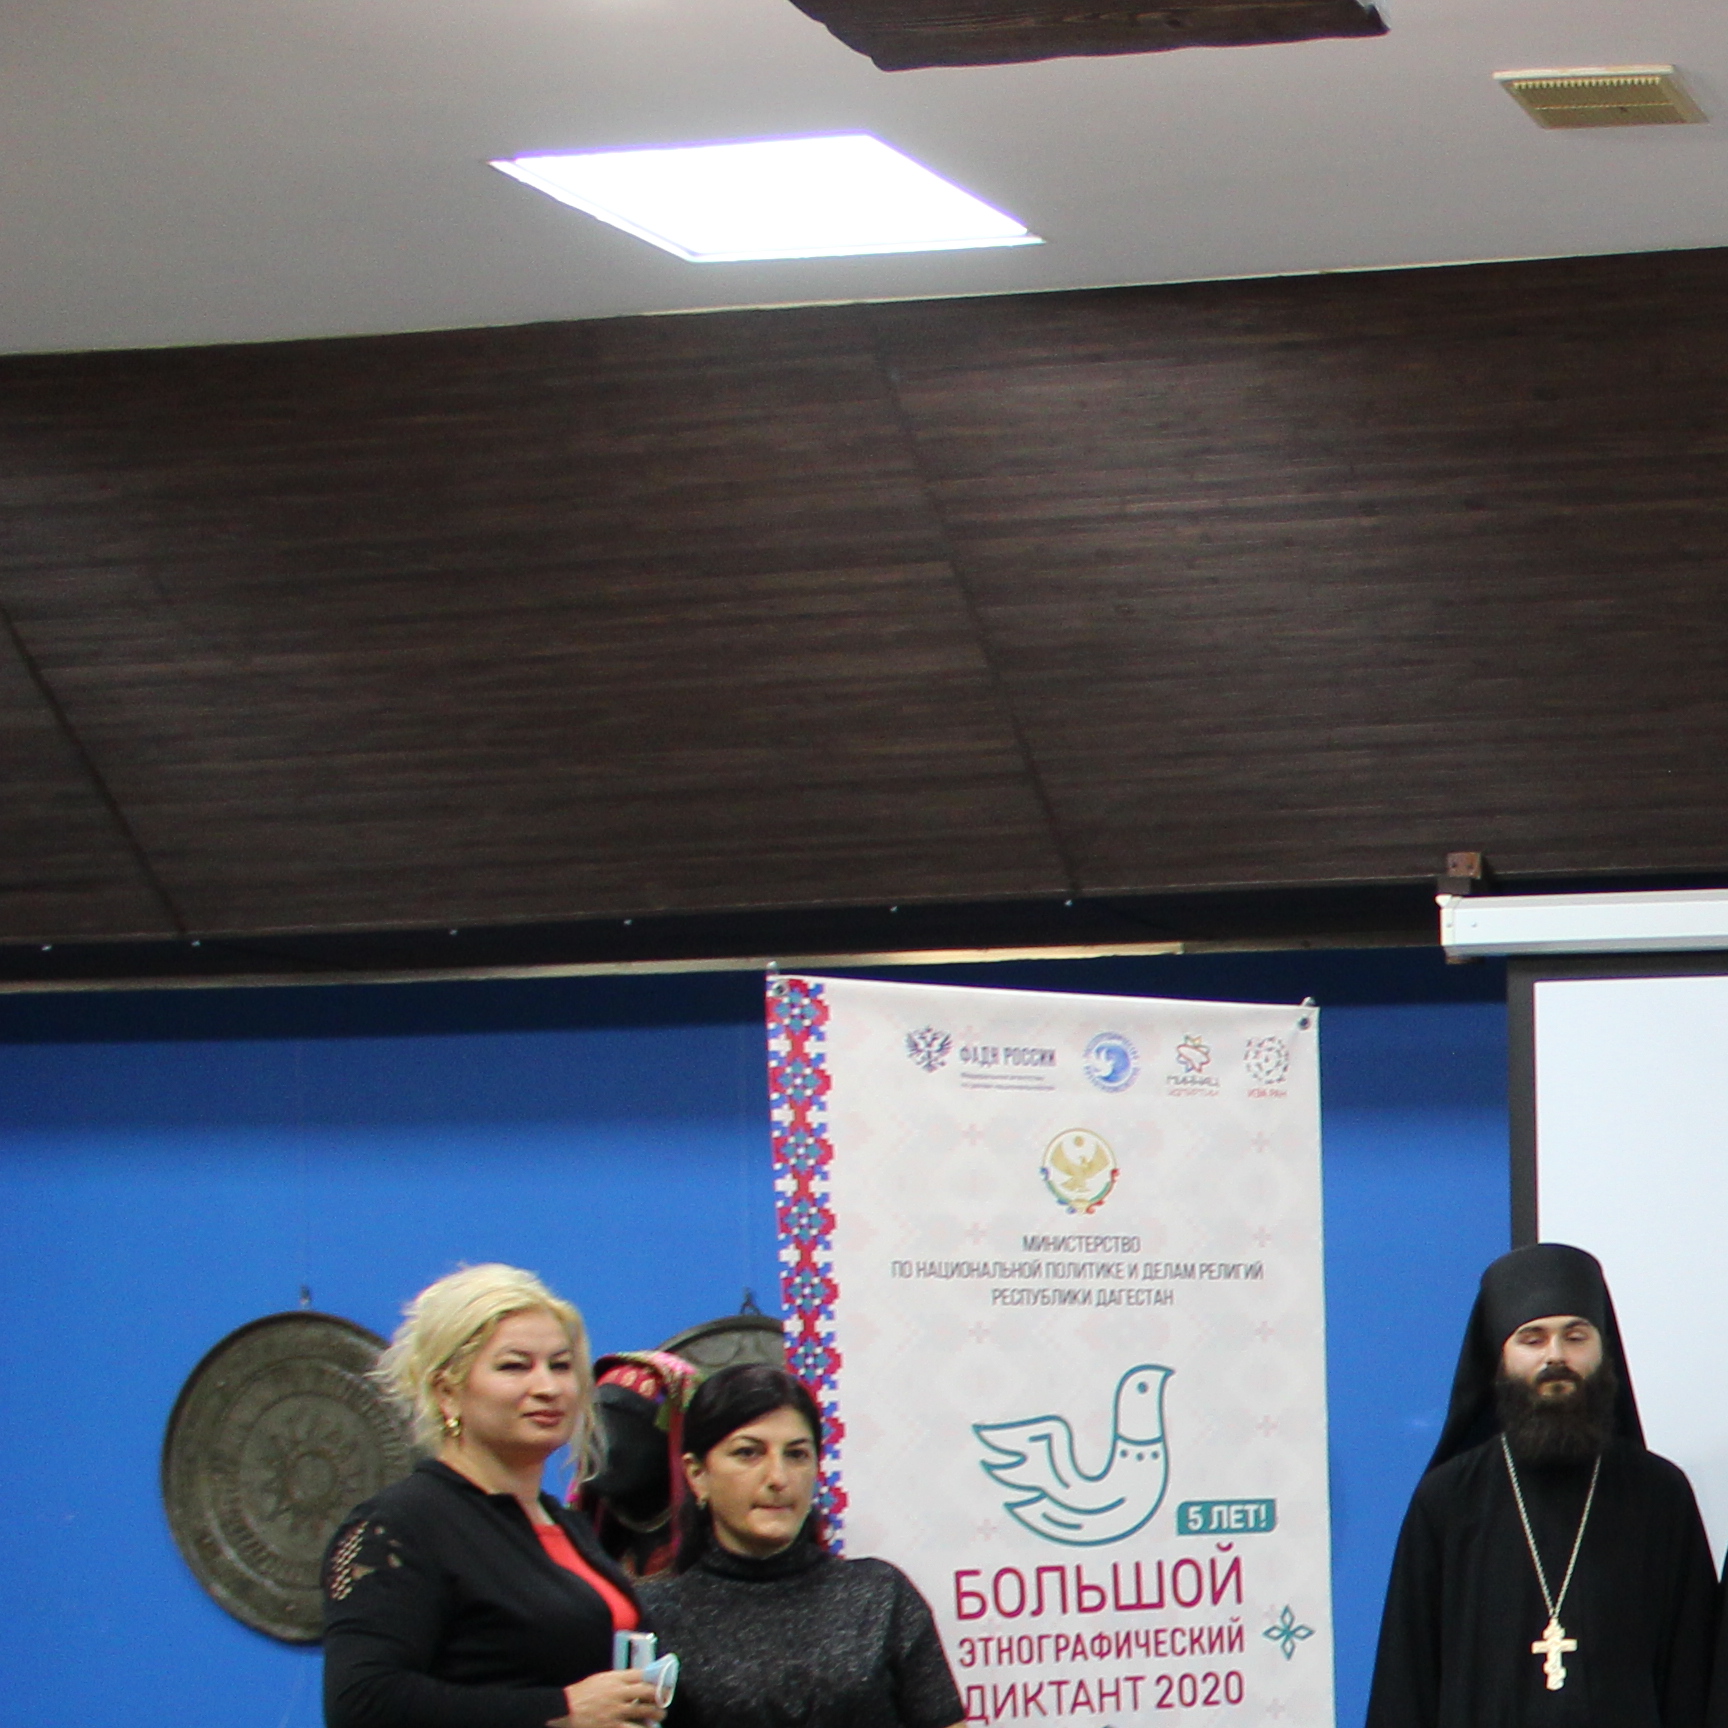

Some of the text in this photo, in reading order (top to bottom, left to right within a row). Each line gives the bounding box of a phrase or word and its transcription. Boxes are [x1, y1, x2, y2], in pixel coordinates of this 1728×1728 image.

[1022, 1235, 1141, 1252] МИНИСТЕРСТВО
[891, 1259, 1265, 1281] ПО НАЦИОНАЛЬНОЙ ПОЛИТИКЕ И ДЕЛАМ РЕЛИГИЙ
[991, 1288, 1174, 1307] РЕСПУБЛИКИ ДАГЕСТАН
[1187, 1503, 1268, 1530] 5 ЛЕТ!
[954, 1540, 1244, 1621] БОЛЬШОЙ
[958, 1617, 1245, 1669] ЭТНОГРАФИЧЕСКИЙ
[964, 1670, 1245, 1726] ДИКТАНТ 2020
